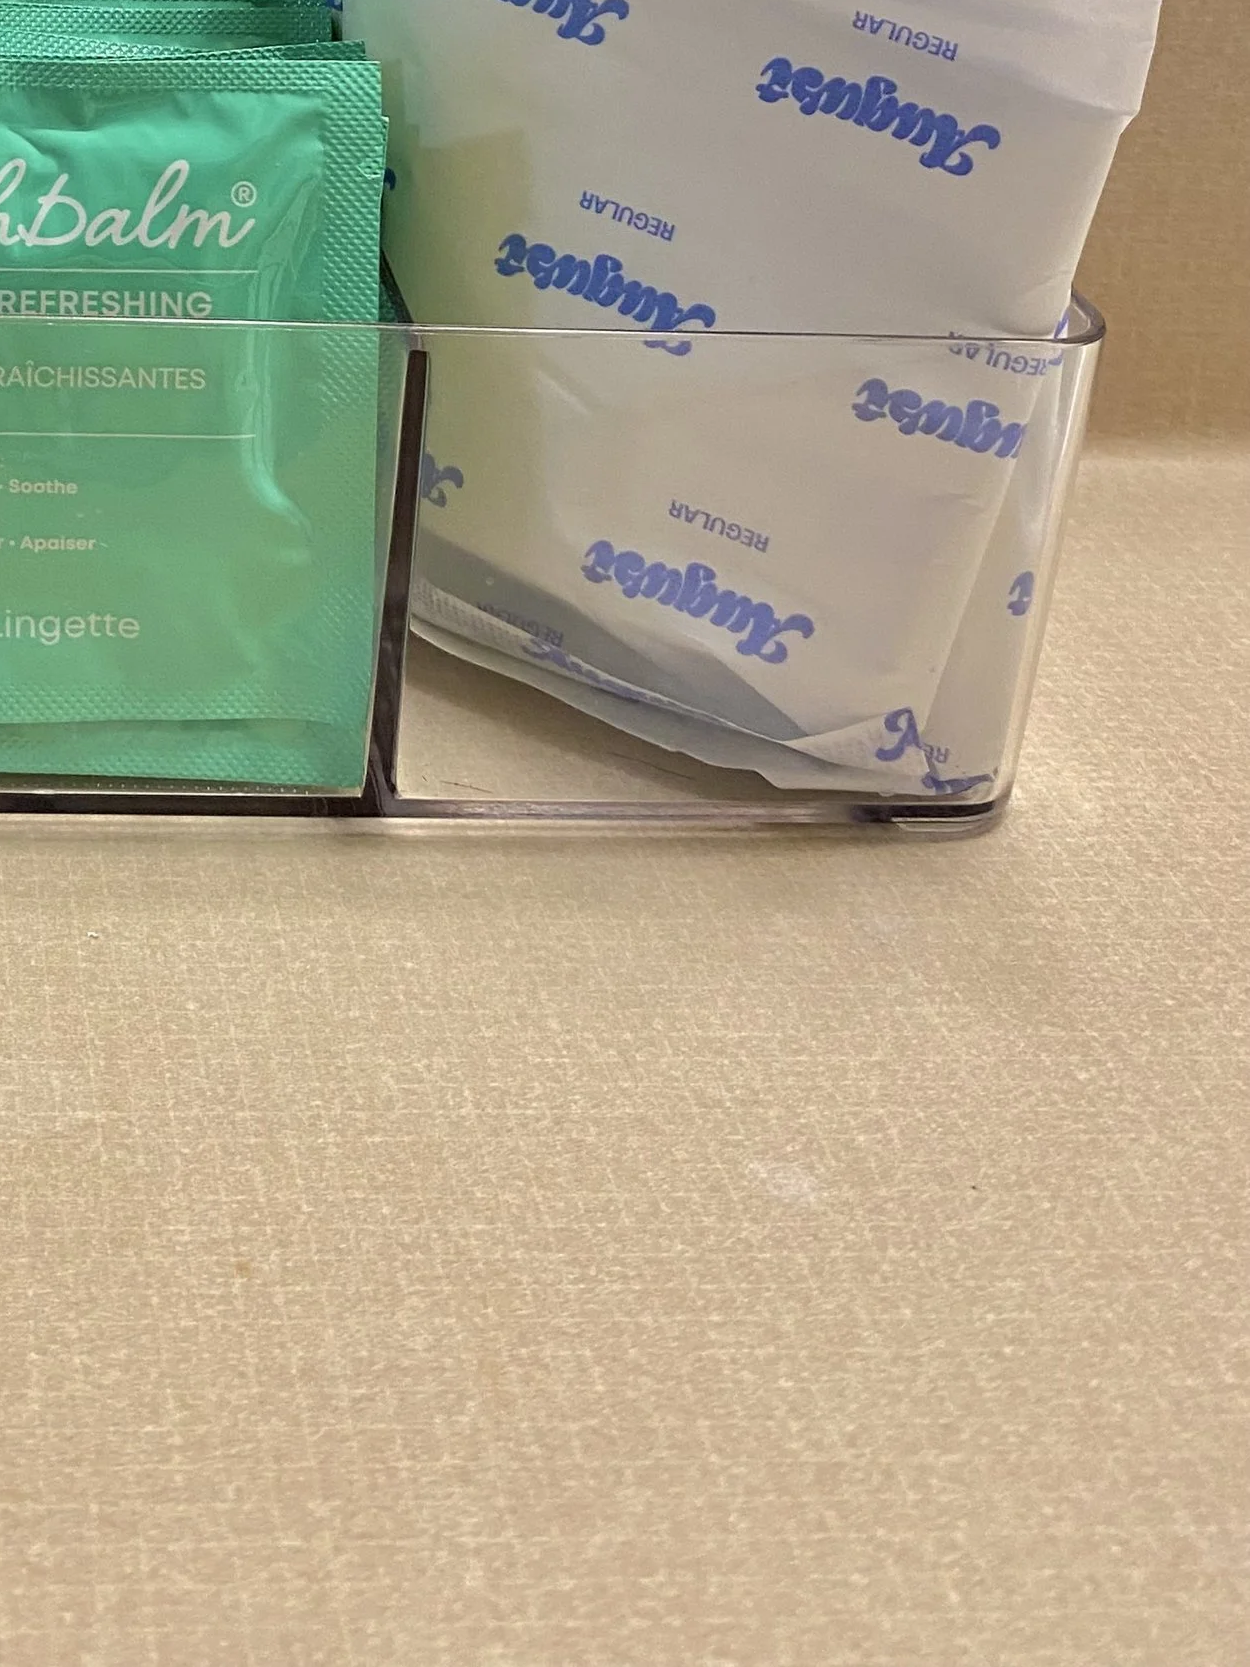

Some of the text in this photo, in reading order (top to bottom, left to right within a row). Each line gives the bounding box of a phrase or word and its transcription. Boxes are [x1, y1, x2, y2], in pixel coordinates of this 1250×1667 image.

[852, 9, 959, 62] REGULAR
[755, 57, 1001, 176] August
[579, 190, 676, 242] REGULAR
[494, 234, 716, 356] August
[8, 478, 78, 494] Soothe
[20, 535, 96, 552] Apaiser
[668, 499, 770, 553] REGULAR
[580, 540, 815, 665] August
